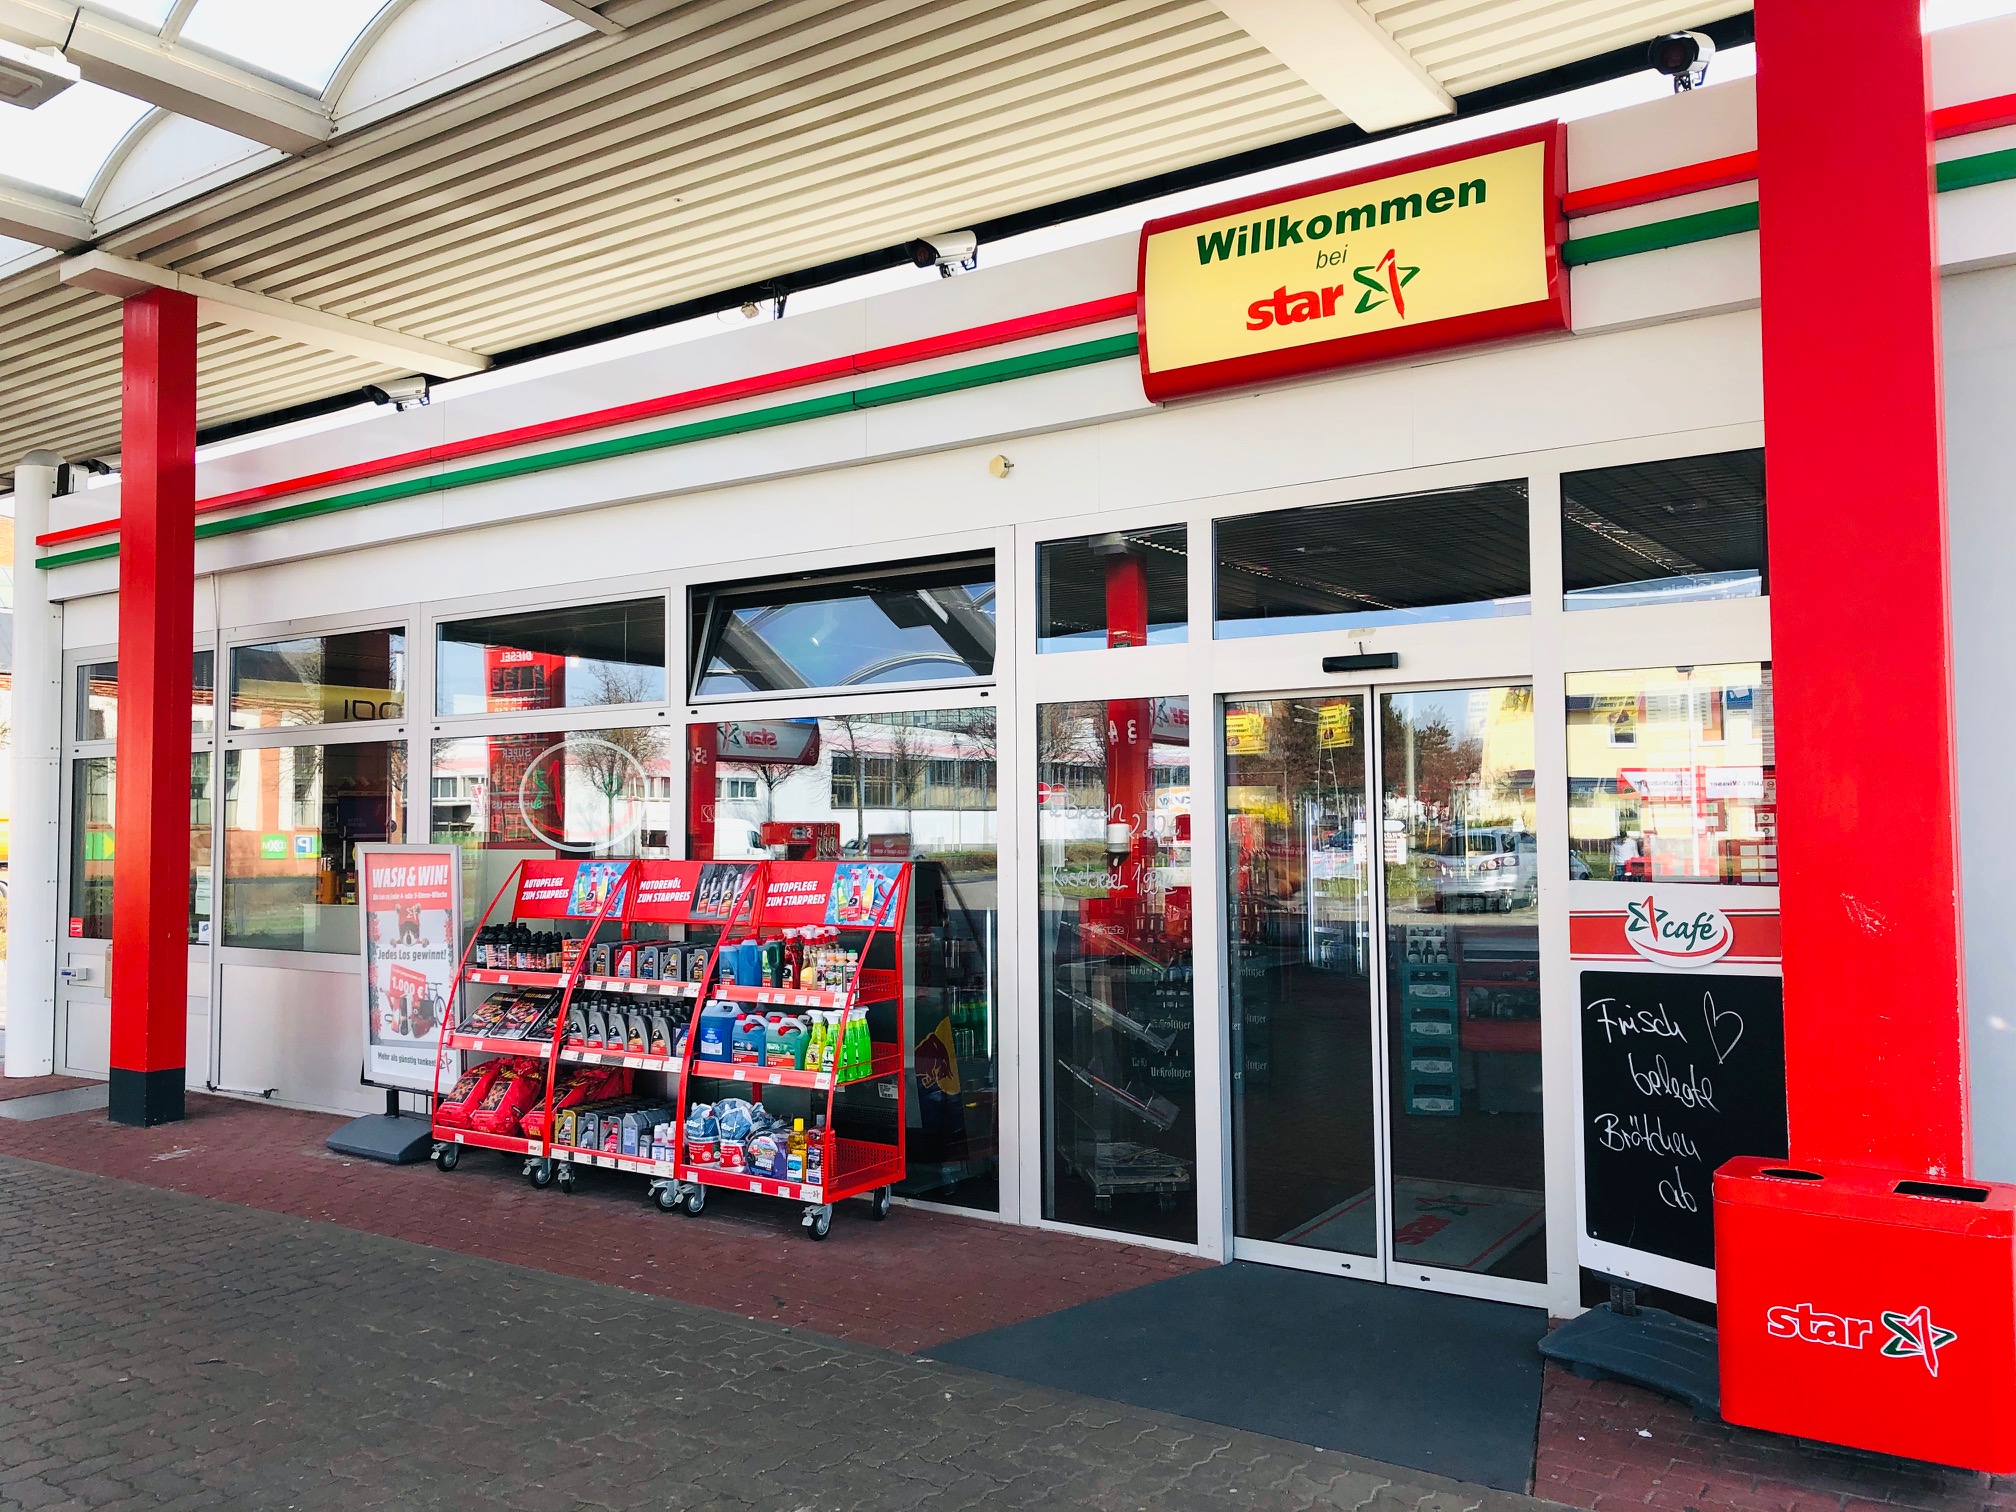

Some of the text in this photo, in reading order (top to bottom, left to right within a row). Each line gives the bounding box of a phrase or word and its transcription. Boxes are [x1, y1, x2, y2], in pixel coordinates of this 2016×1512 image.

[1196, 177, 1487, 266] Willkommen
[1316, 244, 1349, 270] bei
[1245, 283, 1345, 332] star
[372, 864, 449, 888] WASH & WIN!
[523, 877, 565, 889] AUTOPFLEGE
[639, 877, 682, 890] MOTORENÖL
[767, 880, 819, 894] AUTOPFLEGE
[521, 888, 570, 901] ZUM STARPREIS
[637, 890, 691, 903] ZUM STARPREIS
[766, 893, 827, 907] ZUM STARPREIS
[1662, 911, 1718, 951] café
[377, 949, 447, 961] Jedes Los gewinnt!
[392, 977, 415, 995] 1.000
[1587, 997, 1688, 1043] Frisch
[377, 1051, 390, 1061] Mehr
[390, 1052, 398, 1062] als
[398, 1053, 417, 1065] günstig
[1628, 1053, 1721, 1113] belegte
[1594, 1112, 1702, 1162] Brötchen
[1658, 1165, 1699, 1213] ab
[1766, 1302, 1873, 1351] star
